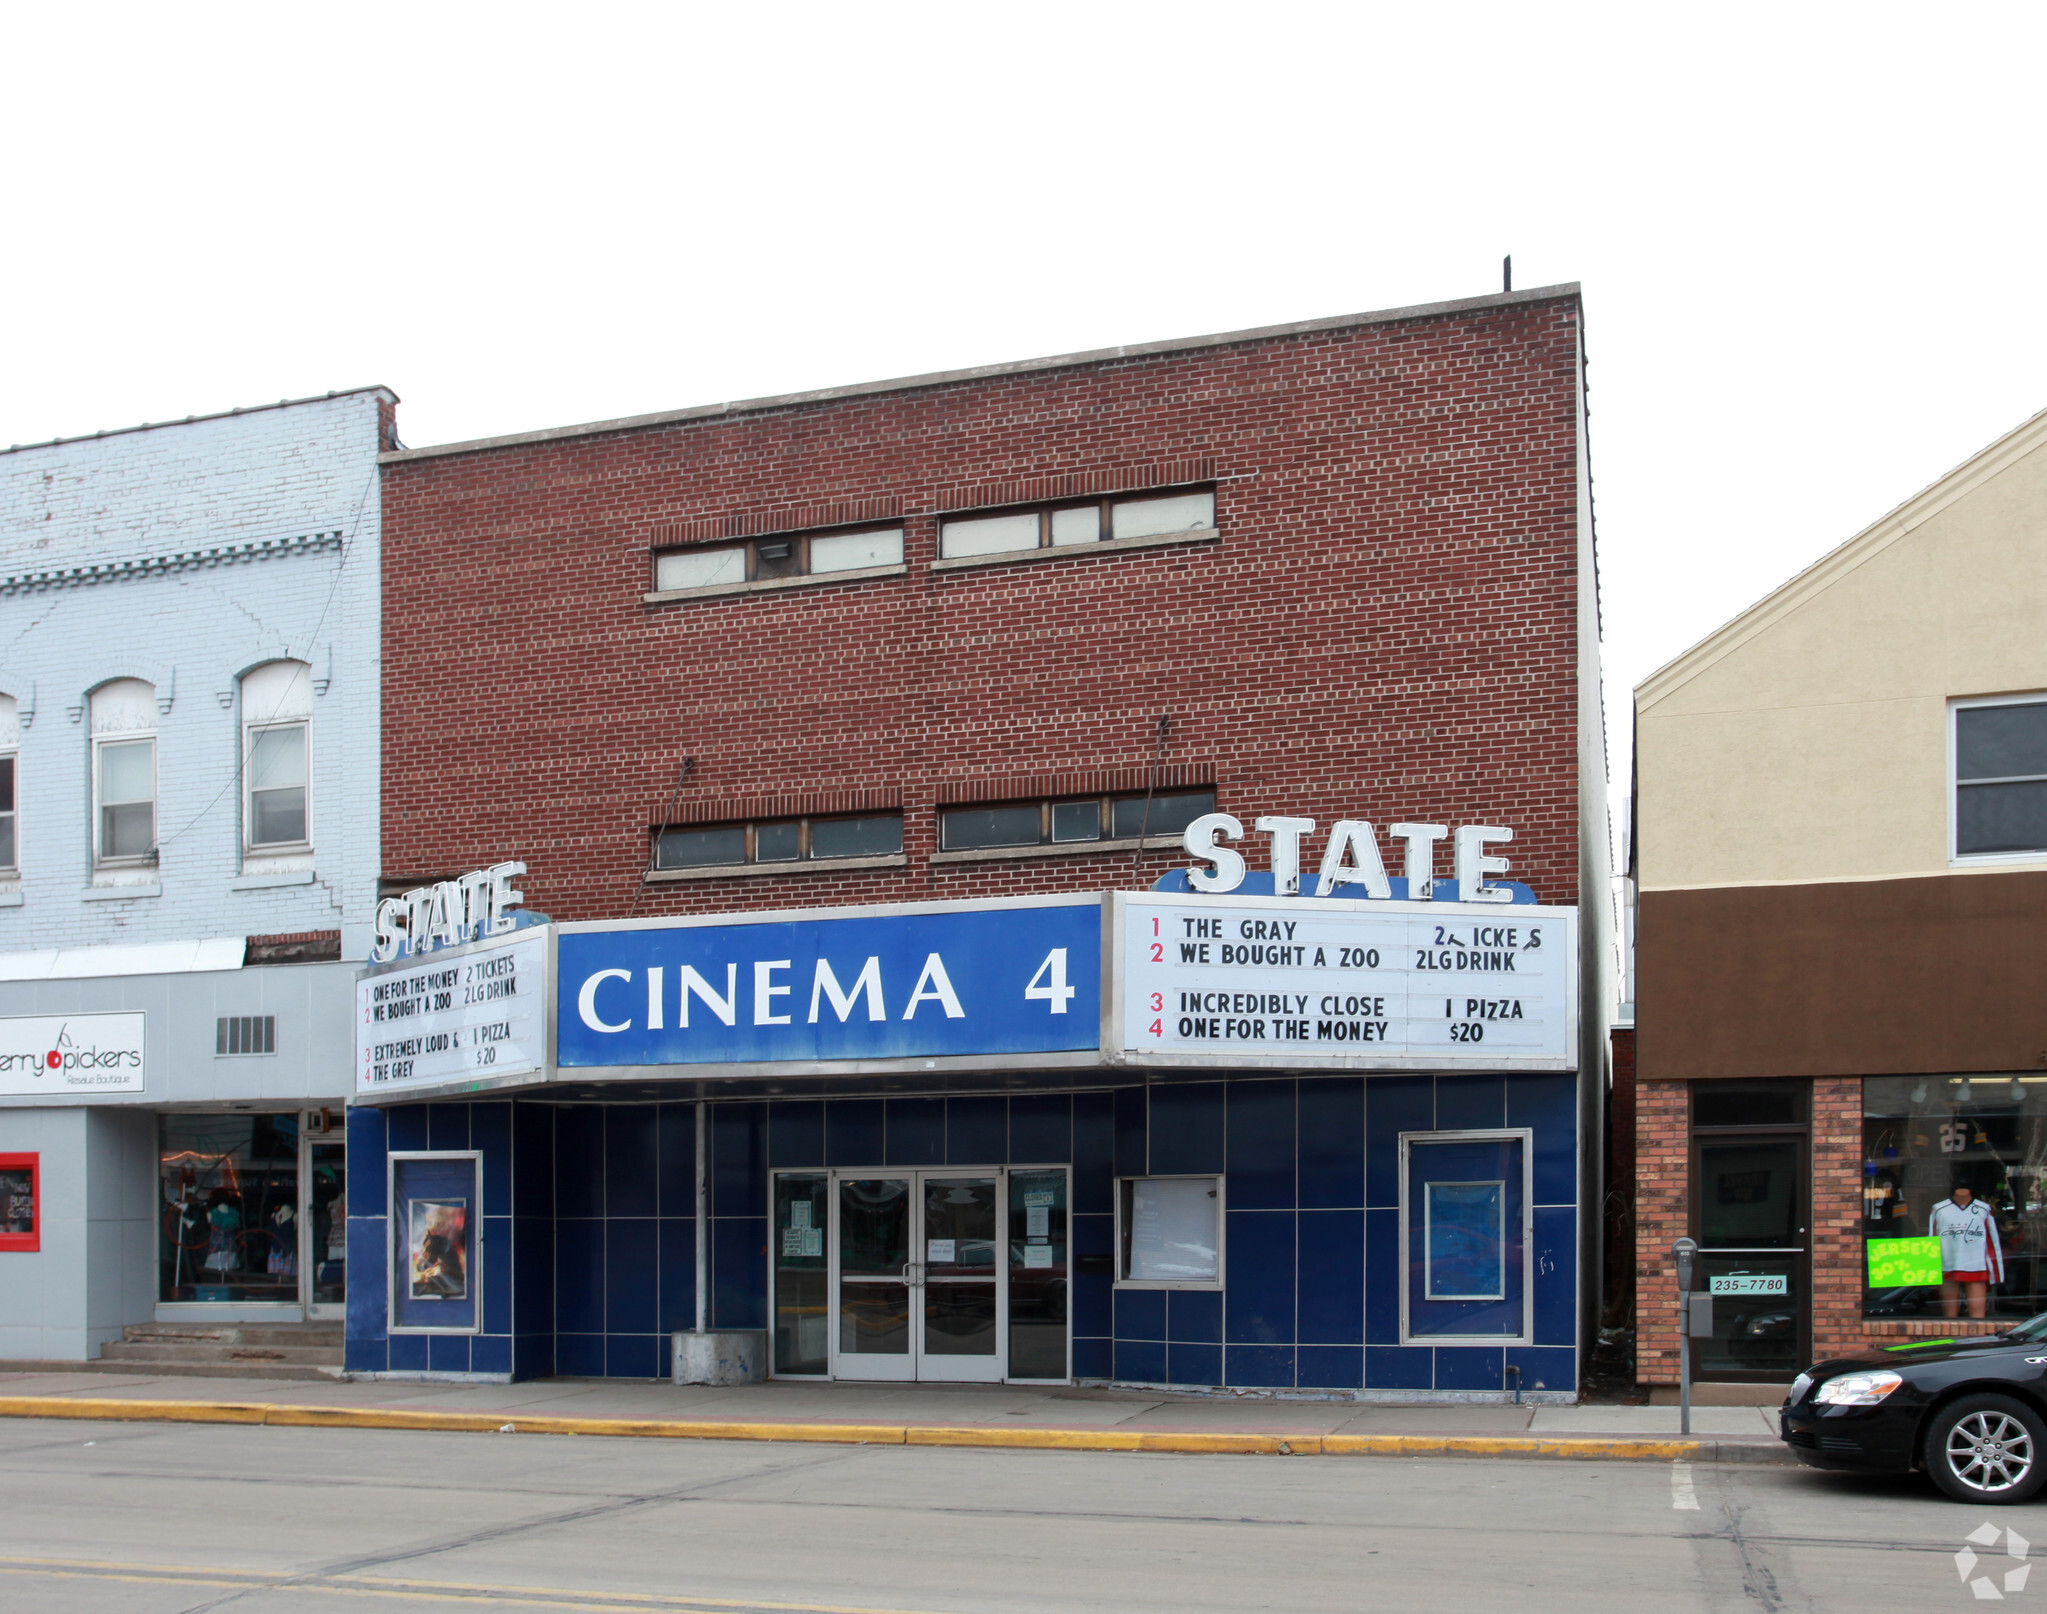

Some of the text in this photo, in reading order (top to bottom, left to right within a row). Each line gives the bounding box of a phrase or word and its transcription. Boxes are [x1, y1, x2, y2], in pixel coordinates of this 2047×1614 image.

[1182, 812, 1514, 904] STATE
[372, 860, 528, 963] STATE
[1150, 918, 1296, 940] 1 THE GRAY
[1435, 926, 1444, 946] 2
[1150, 944, 1380, 968] 2 WE BOUGHT A ZOO
[1457, 951, 1515, 971] DRINK
[466, 955, 515, 983] 2 TICKETS
[365, 968, 460, 1004] 1 ONE FOR THE MONEY
[487, 977, 517, 998] DRINK
[578, 947, 1075, 1033] CINEMA 4
[365, 992, 451, 1023] 2 WE BOUGHT A ZOO
[1150, 992, 1384, 1016] 3 INCREDIBLY CLOSE
[1466, 999, 1522, 1020] PIZZA
[482, 1022, 510, 1043] PIZZA
[1148, 1018, 1388, 1041] 4 ONE FOR THE MONEY
[1450, 1023, 1483, 1042] $20
[365, 1048, 370, 1063] 3
[374, 1038, 422, 1062] EXTREMELY
[426, 1034, 448, 1053] LOUD
[64, 1045, 141, 1076] pickers
[365, 1060, 414, 1082] 4 THE GREY
[1870, 1240, 1940, 1262] JERSEYS
[1872, 1260, 1938, 1284] 30% OFF
[1715, 1280, 1782, 1290] 235-7780
